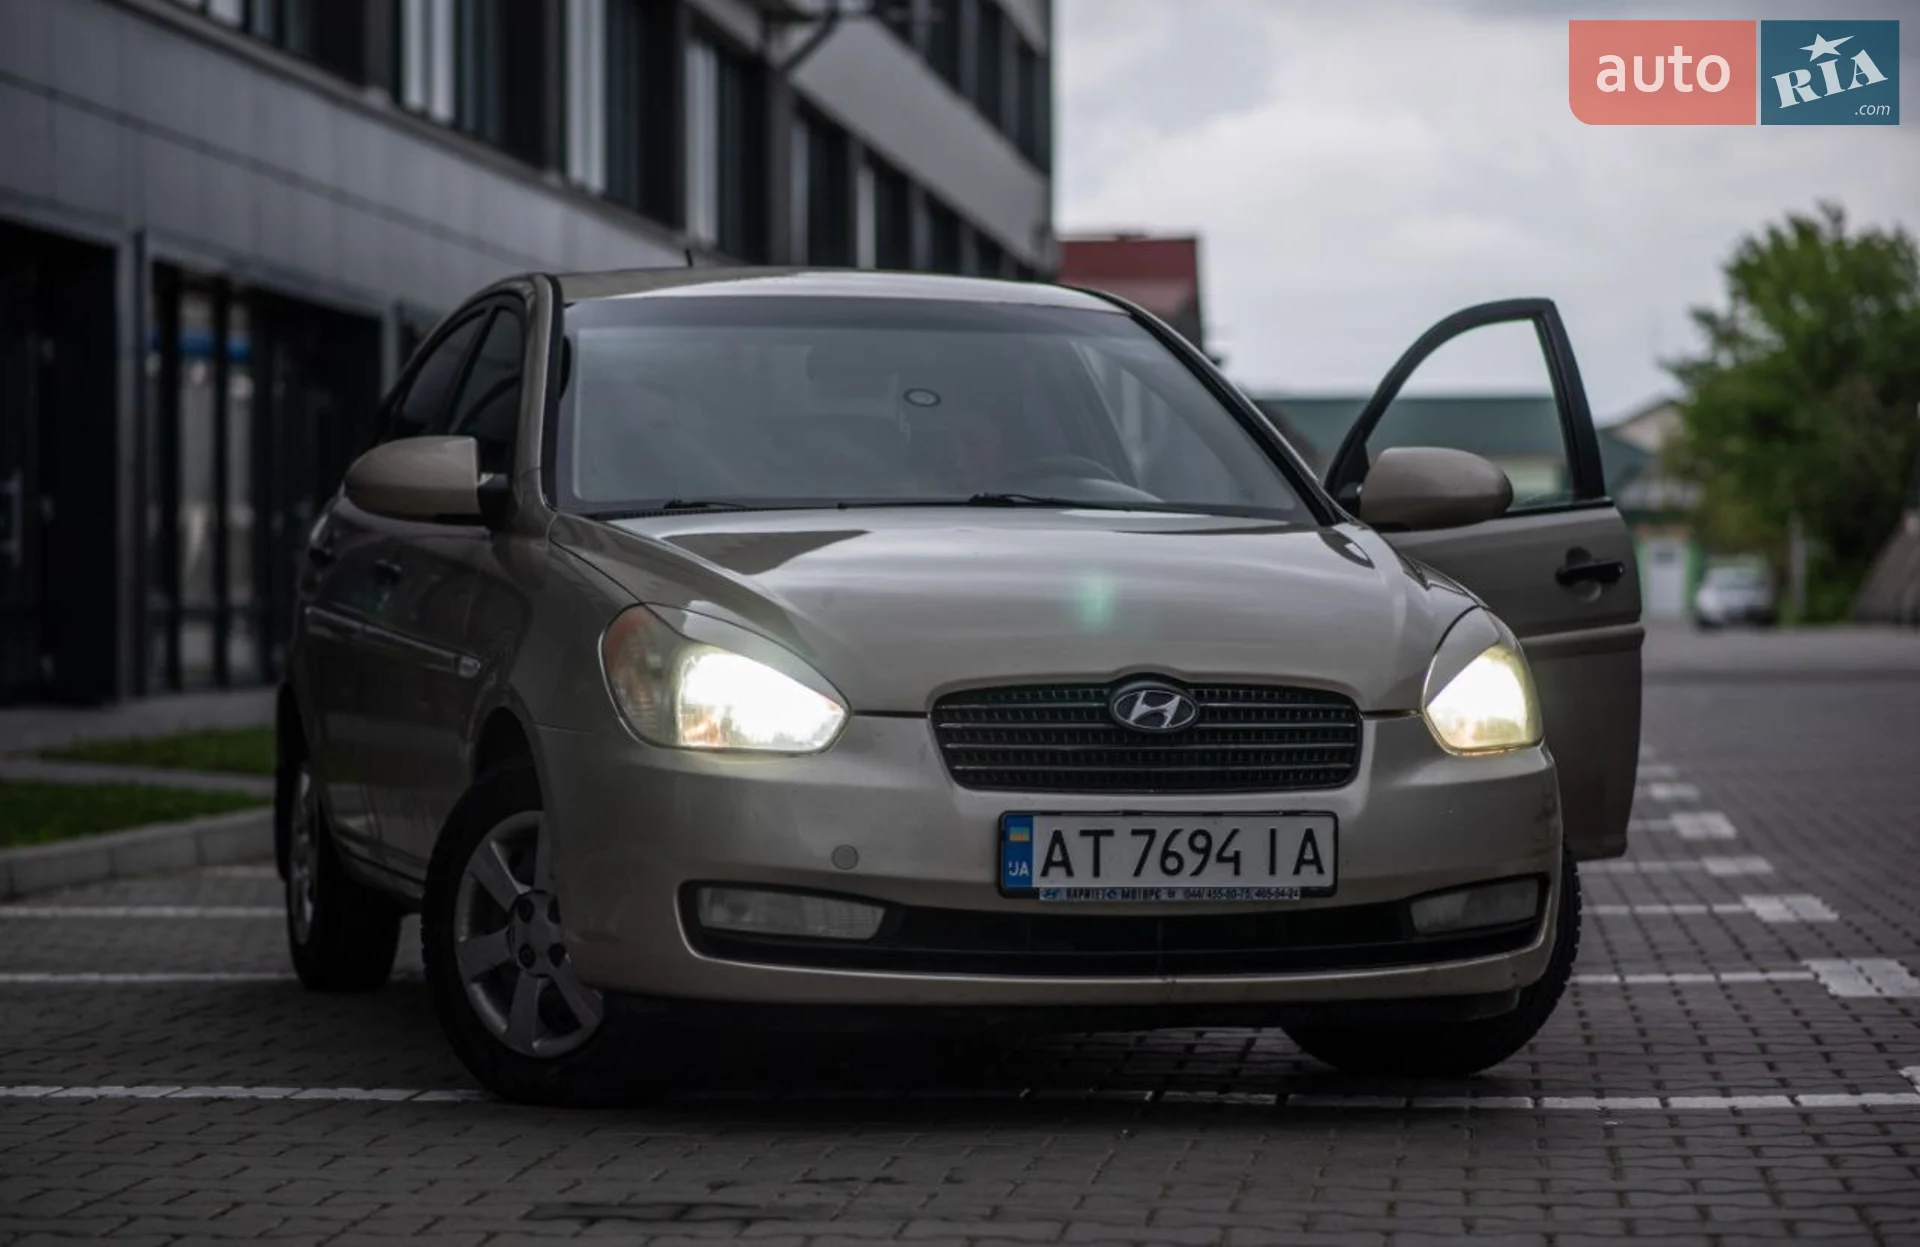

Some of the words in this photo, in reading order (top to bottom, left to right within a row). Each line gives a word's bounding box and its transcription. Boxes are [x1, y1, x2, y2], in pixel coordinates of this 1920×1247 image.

[1008, 860, 1030, 877] UA
[1040, 828, 1115, 877] AT
[1130, 827, 1241, 877] 7694
[1268, 827, 1325, 876] IA
